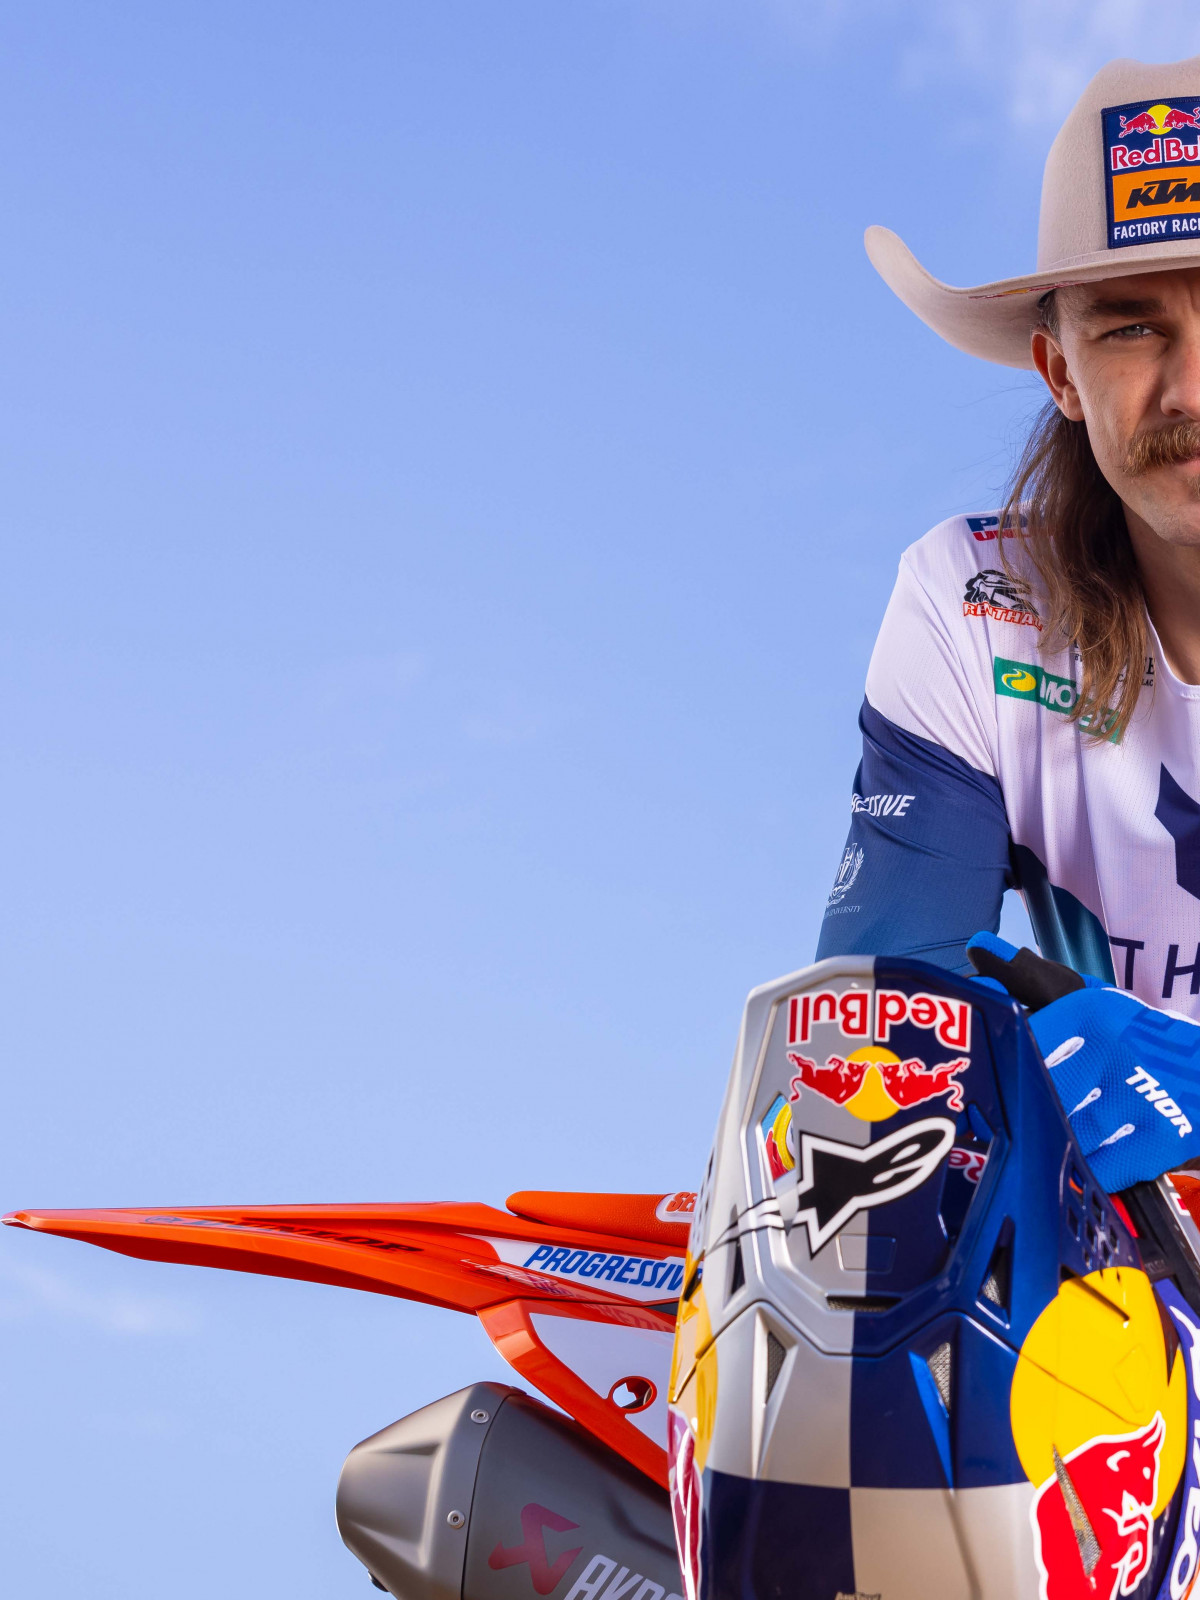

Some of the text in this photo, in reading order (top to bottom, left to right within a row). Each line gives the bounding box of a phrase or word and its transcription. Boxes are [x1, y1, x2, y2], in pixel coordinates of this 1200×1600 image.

[1114, 220, 1167, 240] FACTORY
[1126, 1066, 1192, 1138] THOR
[523, 1245, 702, 1291] PROGRESSIV
